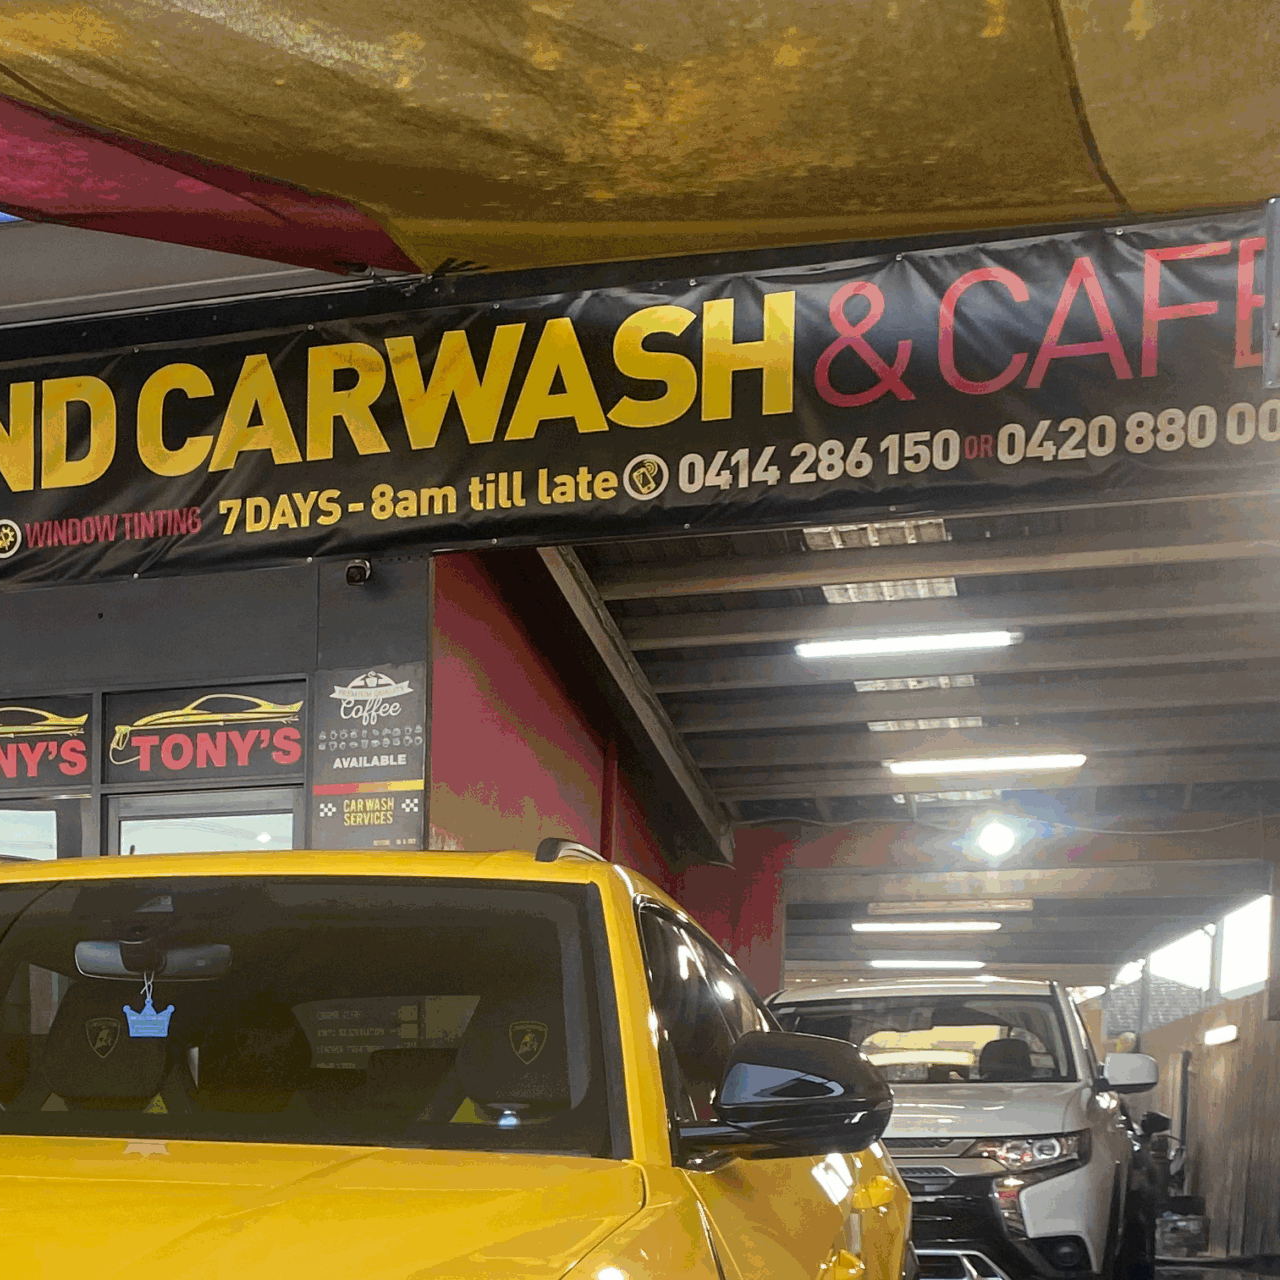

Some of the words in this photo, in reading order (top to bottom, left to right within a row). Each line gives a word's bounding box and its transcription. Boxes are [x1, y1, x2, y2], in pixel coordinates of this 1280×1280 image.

[136, 290, 796, 477] CARWASH
[814, 280, 917, 408] &
[219, 487, 342, 535] 7DAYS
[371, 482, 457, 520] 8am
[468, 470, 526, 511] till
[537, 466, 618, 505] late
[677, 445, 781, 493] 0414
[788, 436, 874, 485] 286
[879, 428, 961, 476] 150
[964, 434, 995, 460] OR
[997, 414, 1117, 465] 0420
[1124, 404, 1218, 454] 880
[26, 514, 119, 549] WINDOW
[122, 506, 202, 540] TINTING
[340, 698, 402, 725] Coffee
[130, 727, 302, 771] TONY'S
[333, 754, 407, 769] AVAILABLE
[343, 799, 364, 813] CAR
[365, 797, 395, 812] WASH
[343, 811, 394, 826] SERVICES
